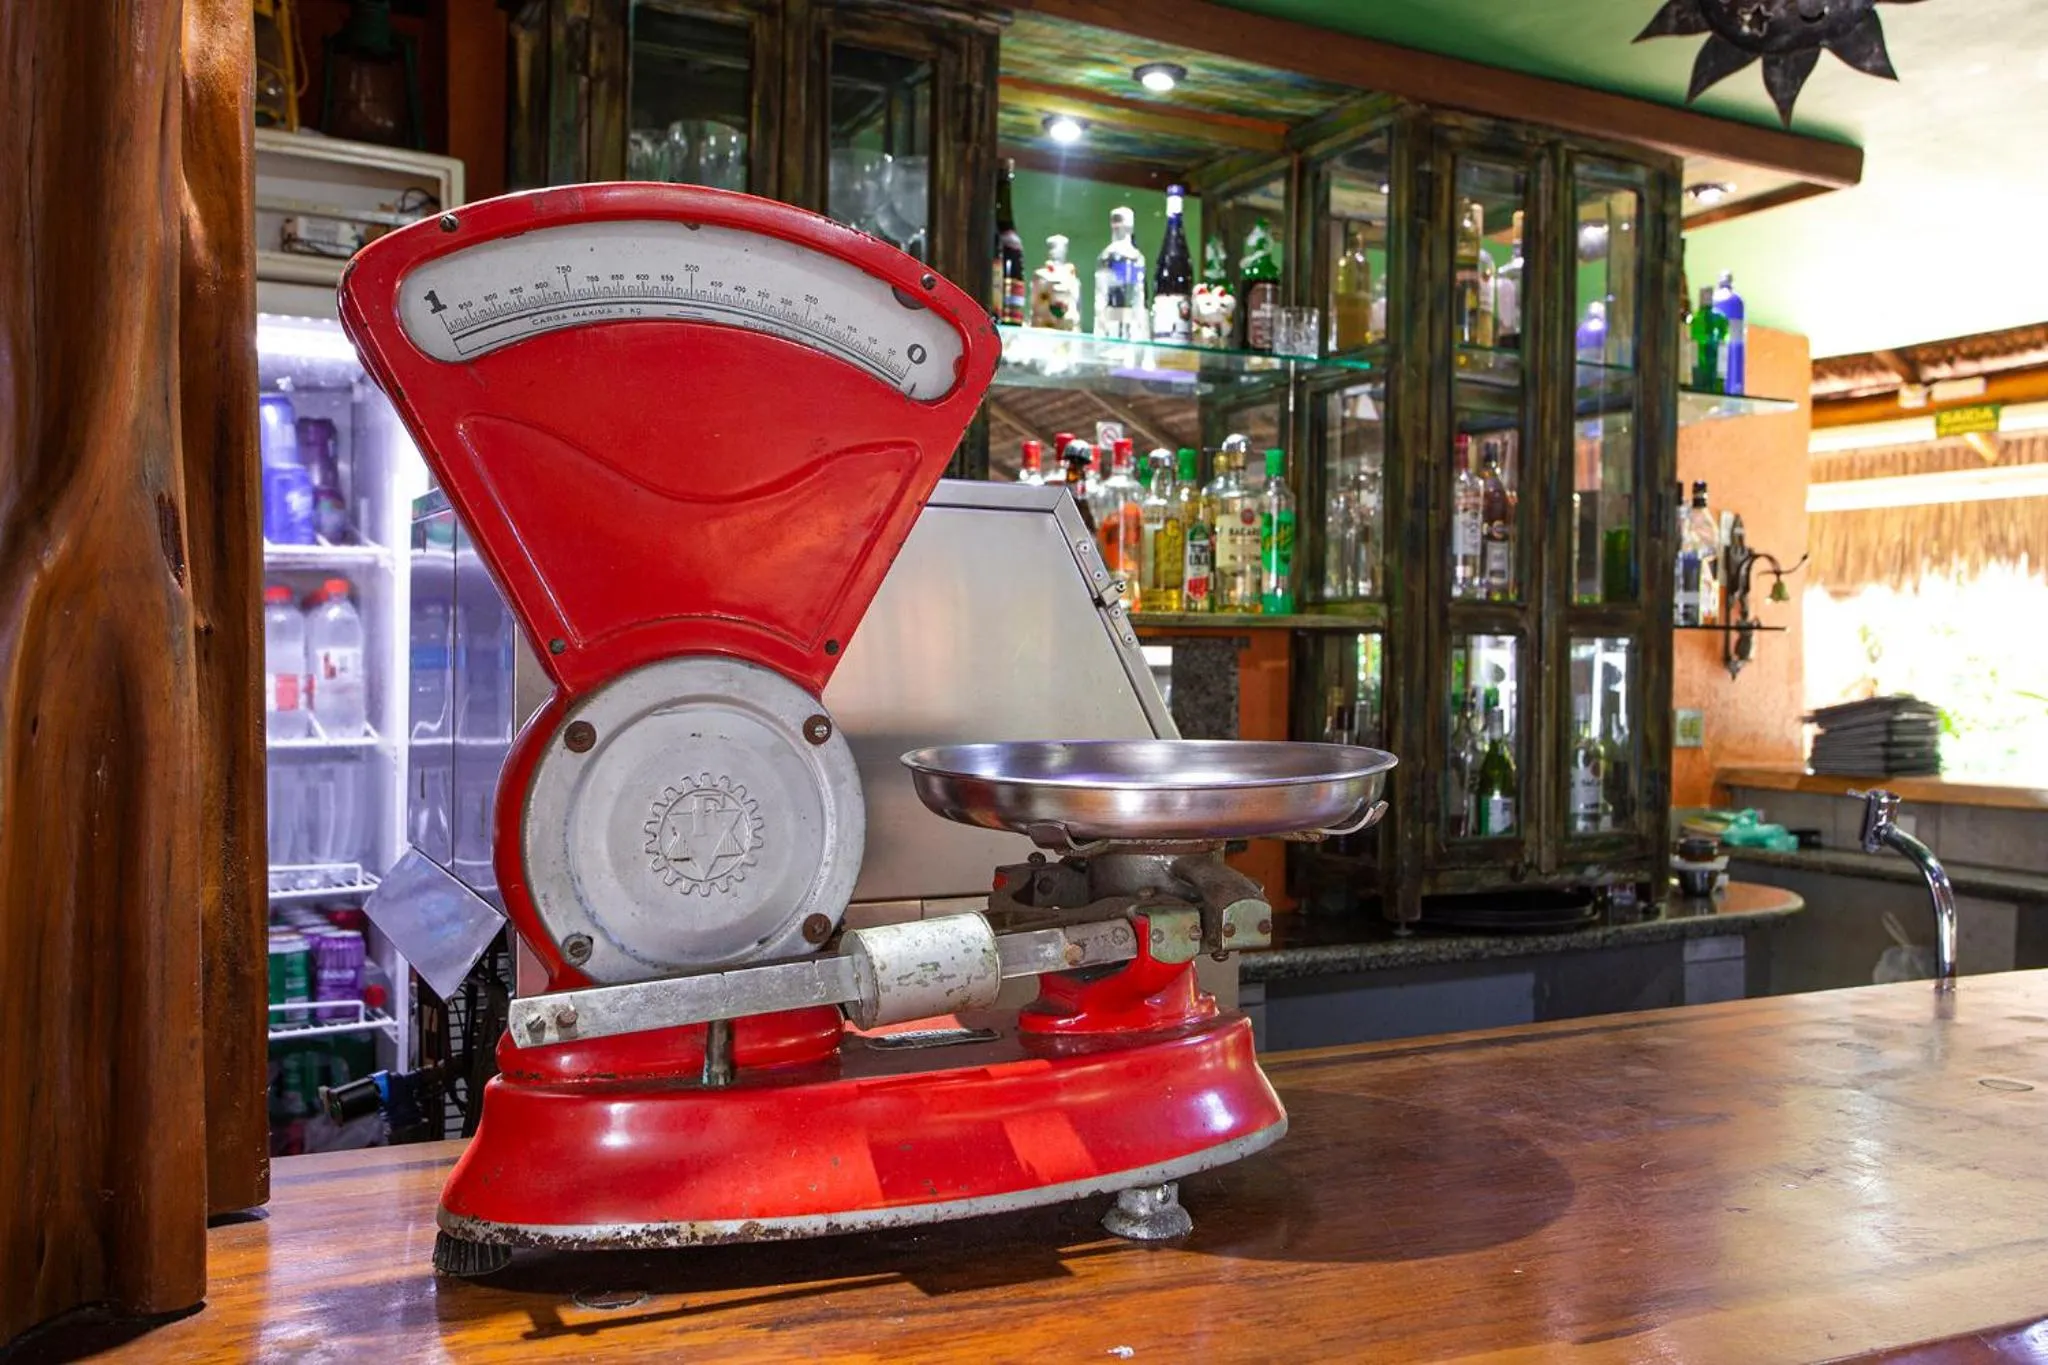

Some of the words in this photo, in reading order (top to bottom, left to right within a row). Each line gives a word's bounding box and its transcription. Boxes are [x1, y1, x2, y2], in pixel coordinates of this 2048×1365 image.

[424, 290, 447, 314] 1
[556, 264, 572, 274] 750
[635, 273, 650, 281] 600
[684, 263, 700, 273] 500
[804, 293, 819, 306] 250
[907, 343, 927, 365] 0
